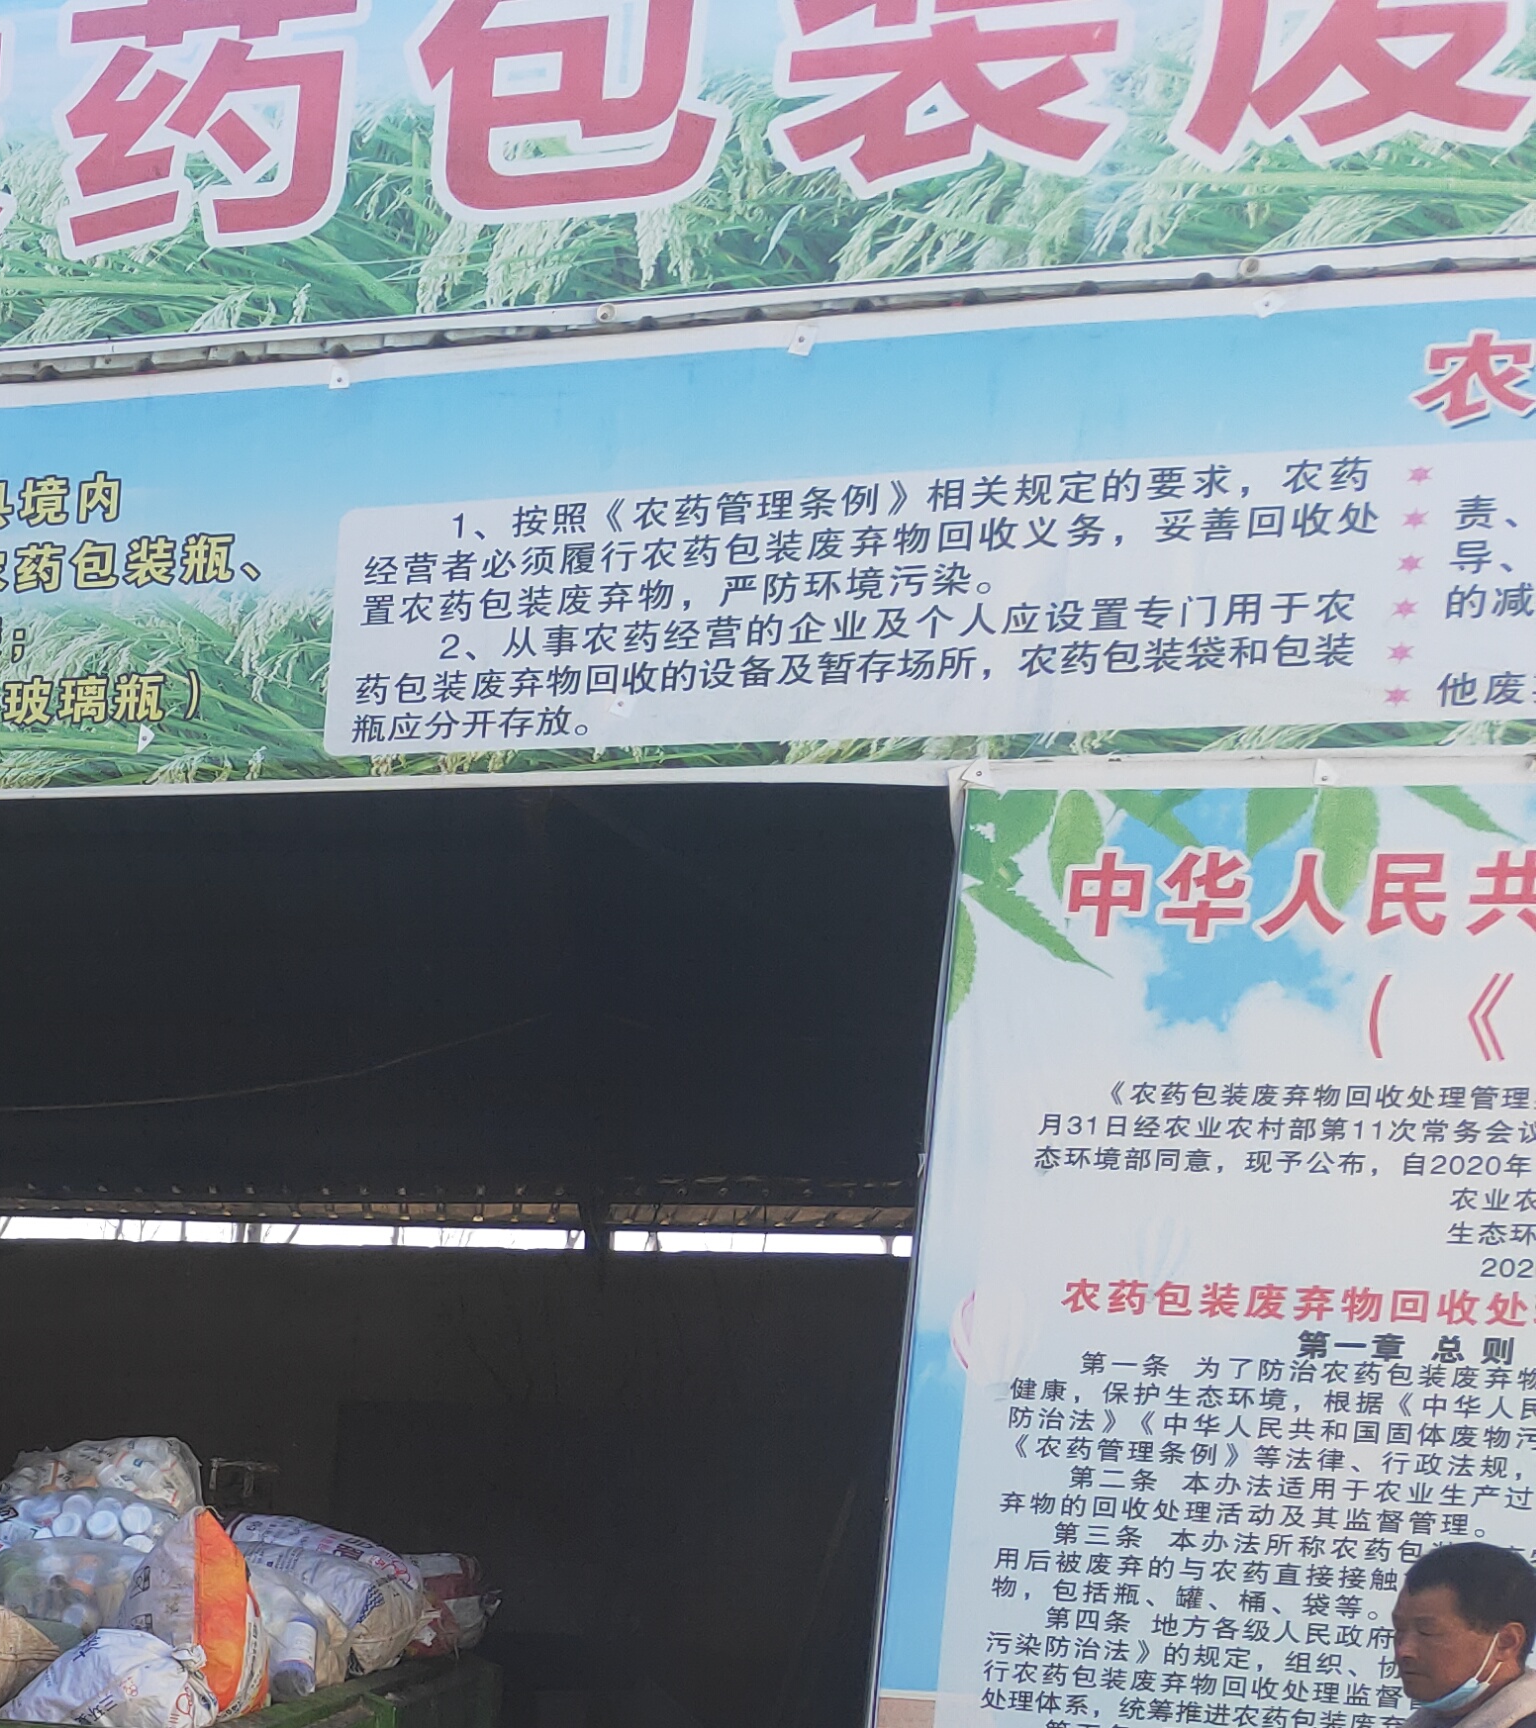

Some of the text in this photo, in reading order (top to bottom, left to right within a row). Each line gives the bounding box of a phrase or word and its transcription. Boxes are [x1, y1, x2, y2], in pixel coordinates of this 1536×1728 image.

[1415, 333, 1536, 422] 农
[451, 456, 1373, 540] 1、按照《农药管理条例》相关规定的要求，农药
[364, 502, 1380, 586] 经营者必须履行农药包装废弃物回收义务，妥善回收处
[360, 561, 994, 628] 置农药包装废弃物，严防环境污染。
[439, 589, 1355, 662] 2、从事农药经营的企业及个人应设置专门用于农
[355, 633, 1355, 706] 药包装废弃物回收的设备及暂存场所，农药包装袋和包装
[1436, 671, 1536, 708] 他废
[351, 704, 590, 744] 瓶应分开存放。
[1067, 850, 1536, 938] 中华人民共
[1110, 1080, 1536, 1110] 《农药包装废弃物回收处理管理
[1033, 1146, 1533, 1180] 态环境部同意，现予公布，自2020年
[1449, 1186, 1536, 1213] 农业农
[1446, 1221, 1536, 1247] 生态环
[1480, 1257, 1536, 1280] 202
[1061, 1277, 1536, 1328] 农药包装废弃物回收处
[1012, 1435, 1524, 1482] 《农药管理条例》等法律、行政法规，
[999, 1492, 1487, 1539] 弃物的回收处理活动及其监督管理。
[1168, 1528, 1453, 1564] 本办法所称农药包
[994, 1548, 1408, 1592] 用后被废弃的与农药直接接触
[991, 1576, 1379, 1621] 物，包括瓶、罐、桶、袋等。
